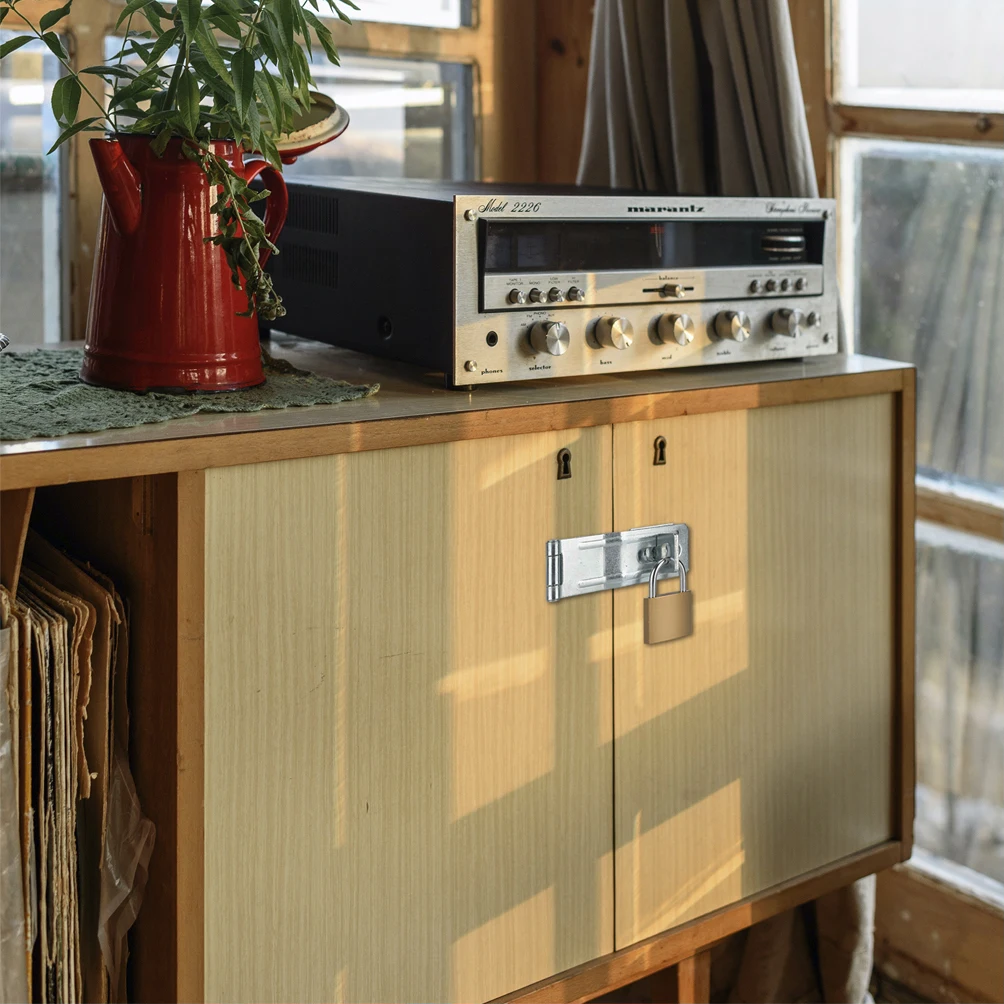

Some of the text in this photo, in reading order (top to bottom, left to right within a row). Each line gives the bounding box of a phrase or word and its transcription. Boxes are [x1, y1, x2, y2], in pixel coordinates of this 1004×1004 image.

[478, 198, 542, 213] Model 2226
[627, 204, 705, 213] marantz
[528, 363, 552, 371] selector
[480, 368, 504, 376] phones
